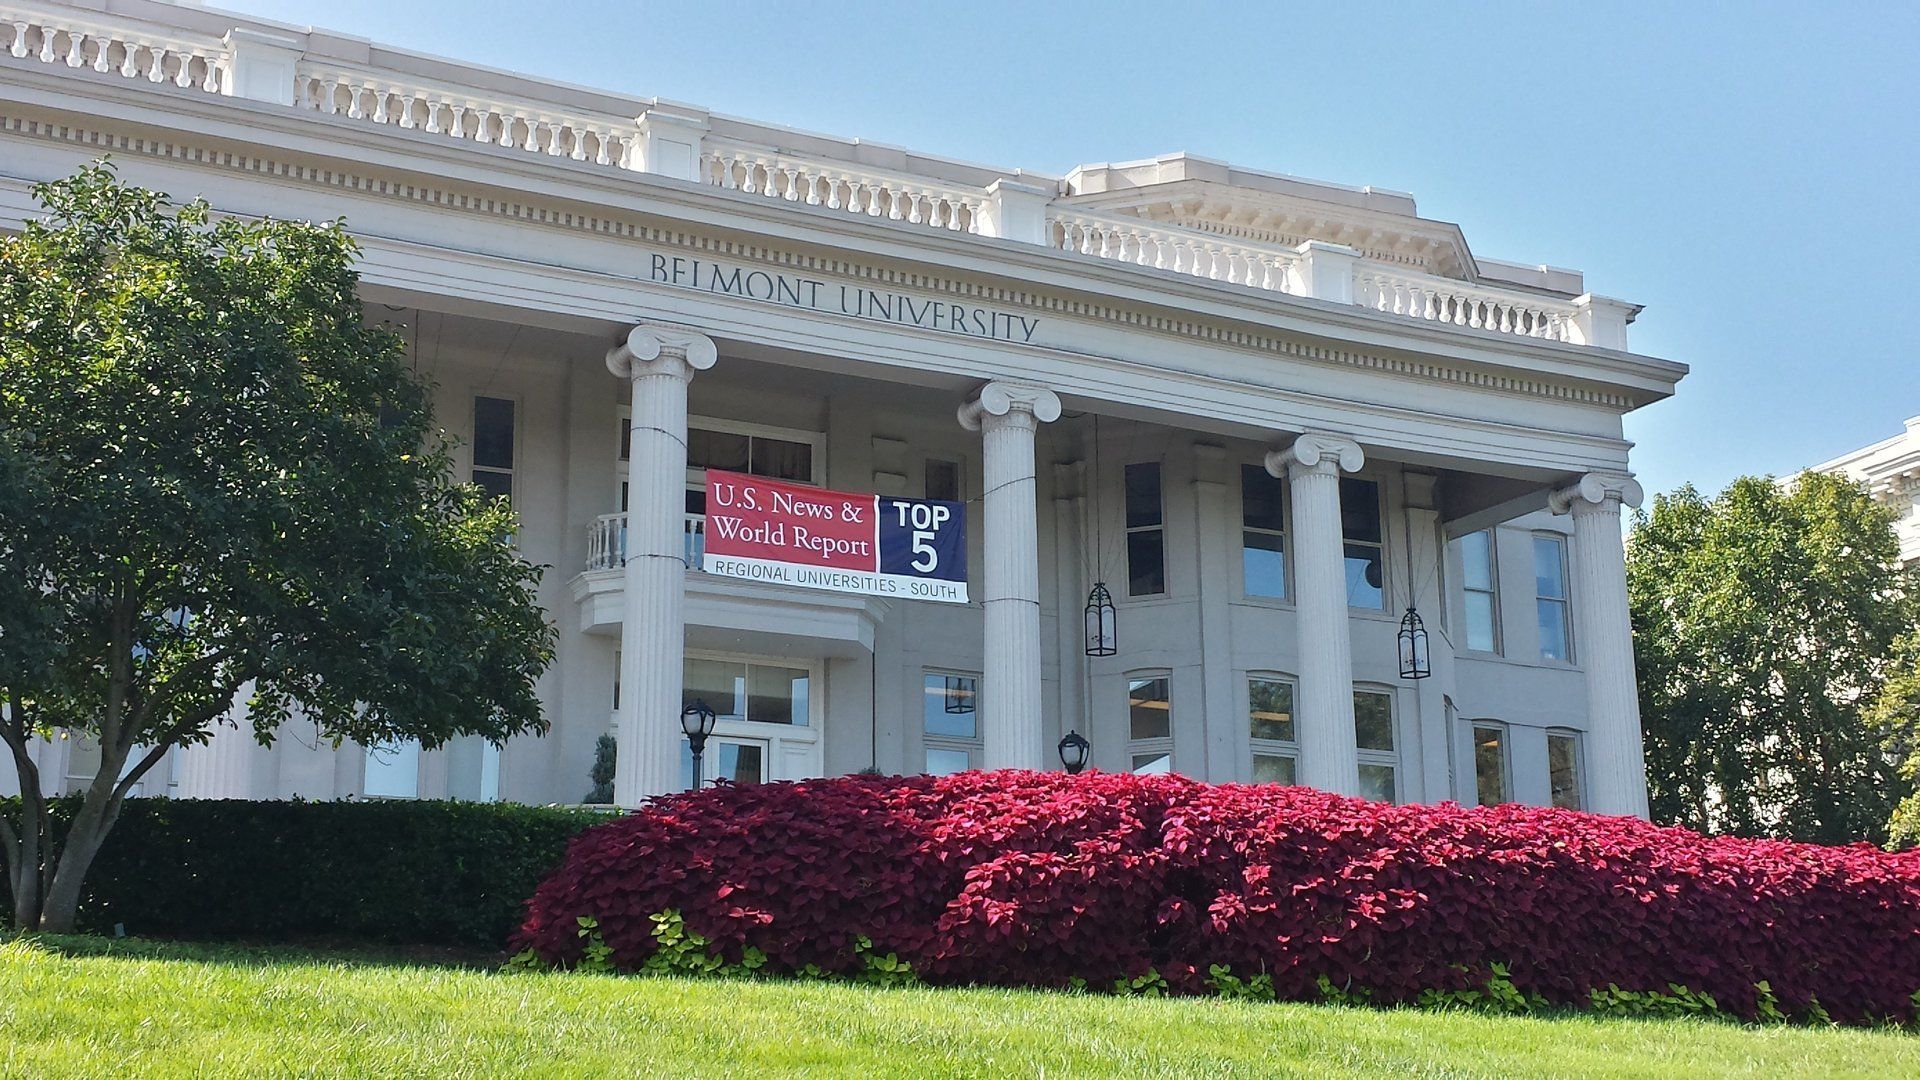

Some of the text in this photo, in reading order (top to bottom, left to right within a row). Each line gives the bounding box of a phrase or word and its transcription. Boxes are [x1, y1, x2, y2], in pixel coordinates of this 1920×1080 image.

[651, 253, 1040, 342] BELMONT UNIVERSITY
[713, 482, 863, 523] U.S. News &
[892, 501, 950, 531] TOP
[712, 515, 870, 559] World Report
[910, 531, 938, 573] 5
[715, 560, 791, 582] REGIONAL
[797, 569, 896, 593] UNIVERSITIES
[911, 582, 957, 599] SOUTH
